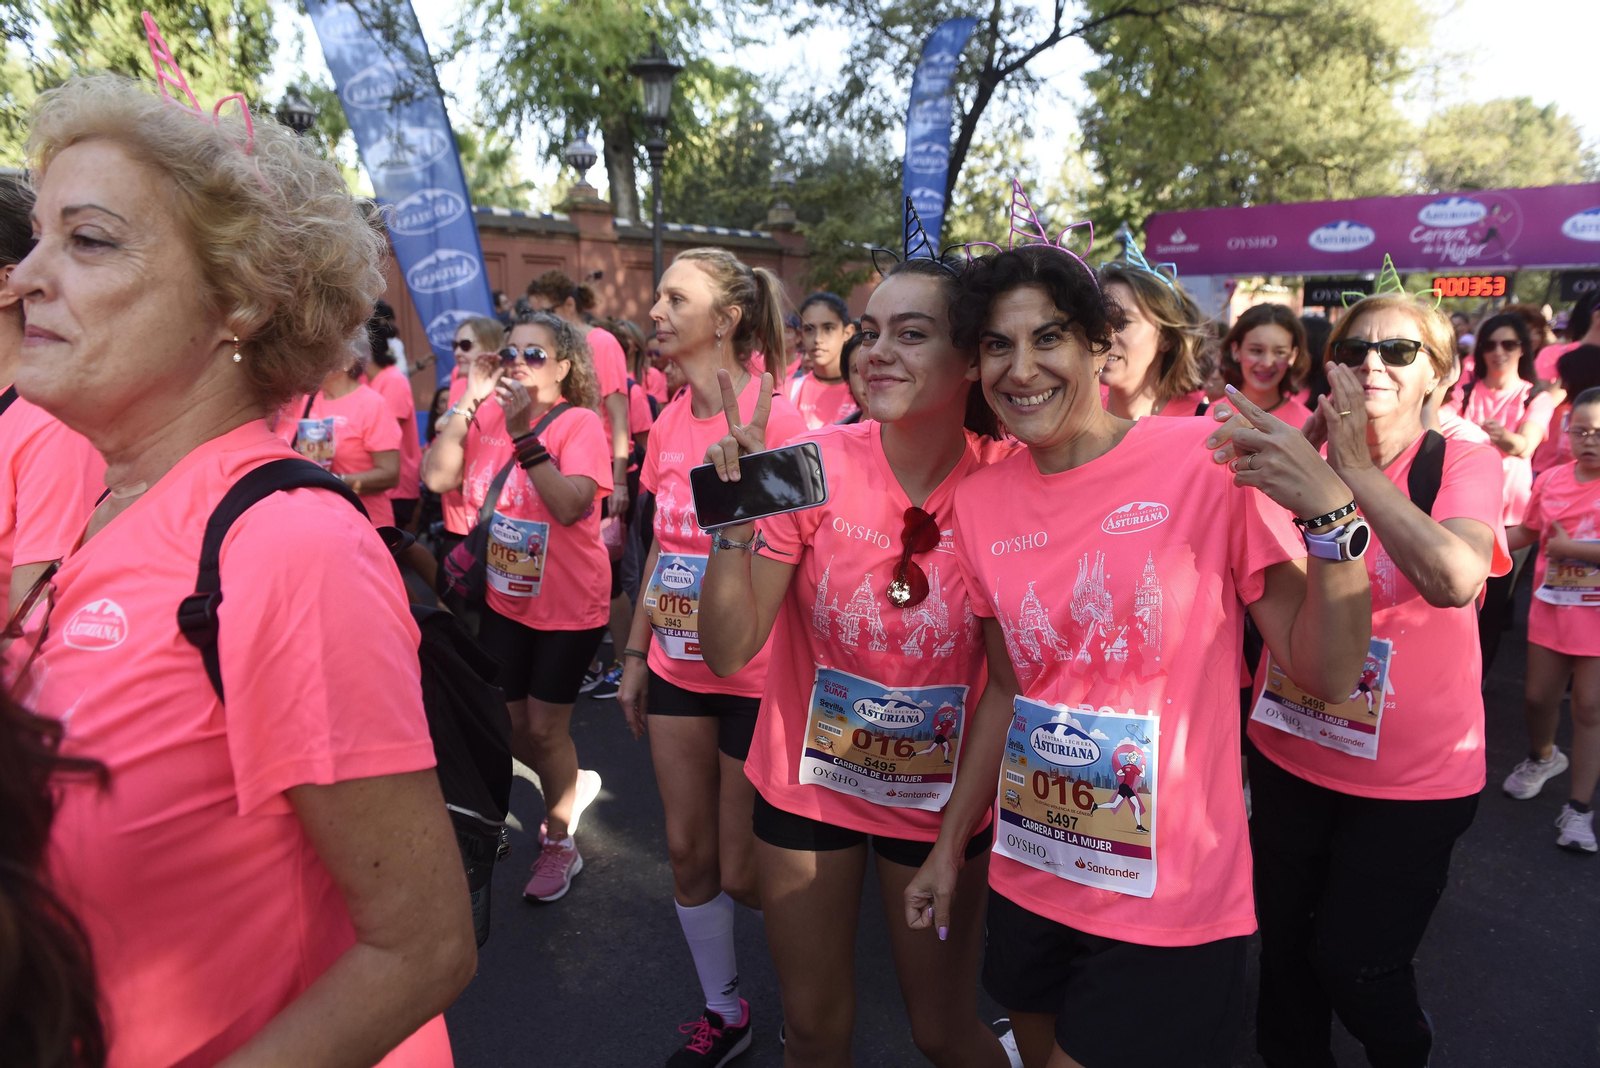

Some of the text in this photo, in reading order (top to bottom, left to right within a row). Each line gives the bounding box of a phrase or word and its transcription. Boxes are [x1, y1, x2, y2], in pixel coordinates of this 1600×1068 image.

[1227, 235, 1277, 250] OYSHO
[1409, 225, 1468, 243] Carrera
[1156, 243, 1200, 254] Santander
[1440, 238, 1488, 265] Mujer
[1434, 276, 1506, 297] 000353
[659, 451, 685, 463] OYSHO
[1105, 511, 1163, 530] ASTURIANA
[832, 516, 891, 550] OYSHO
[491, 542, 517, 562] 016
[990, 531, 1048, 556] OYSHO
[663, 572, 692, 584] ASTURIANA
[659, 593, 692, 615] 016
[664, 617, 682, 628] 3943
[824, 684, 848, 700] SUMA
[869, 704, 894, 713] CENTRAL
[1282, 698, 1349, 727] CARRERA DE LA MUJER
[1301, 695, 1325, 711] 5498
[857, 703, 920, 724] ASTURIANA
[1266, 707, 1300, 727] OYSHO
[851, 728, 915, 758] 016
[1033, 733, 1095, 761] ASTURIANA
[1041, 733, 1092, 747] CENTRAL LECHERA
[1328, 731, 1365, 748] Santander
[833, 757, 922, 783] CARRERA DE LA MUJER
[864, 757, 896, 772] 5495
[813, 766, 859, 788] OYSHO
[897, 790, 940, 800] Santander
[1032, 770, 1095, 811] 016
[1046, 810, 1079, 830] 5497
[1021, 818, 1112, 852] CARRERA DE LA MUJER
[1007, 833, 1047, 859] OYSHO
[1087, 861, 1140, 880] Santander
